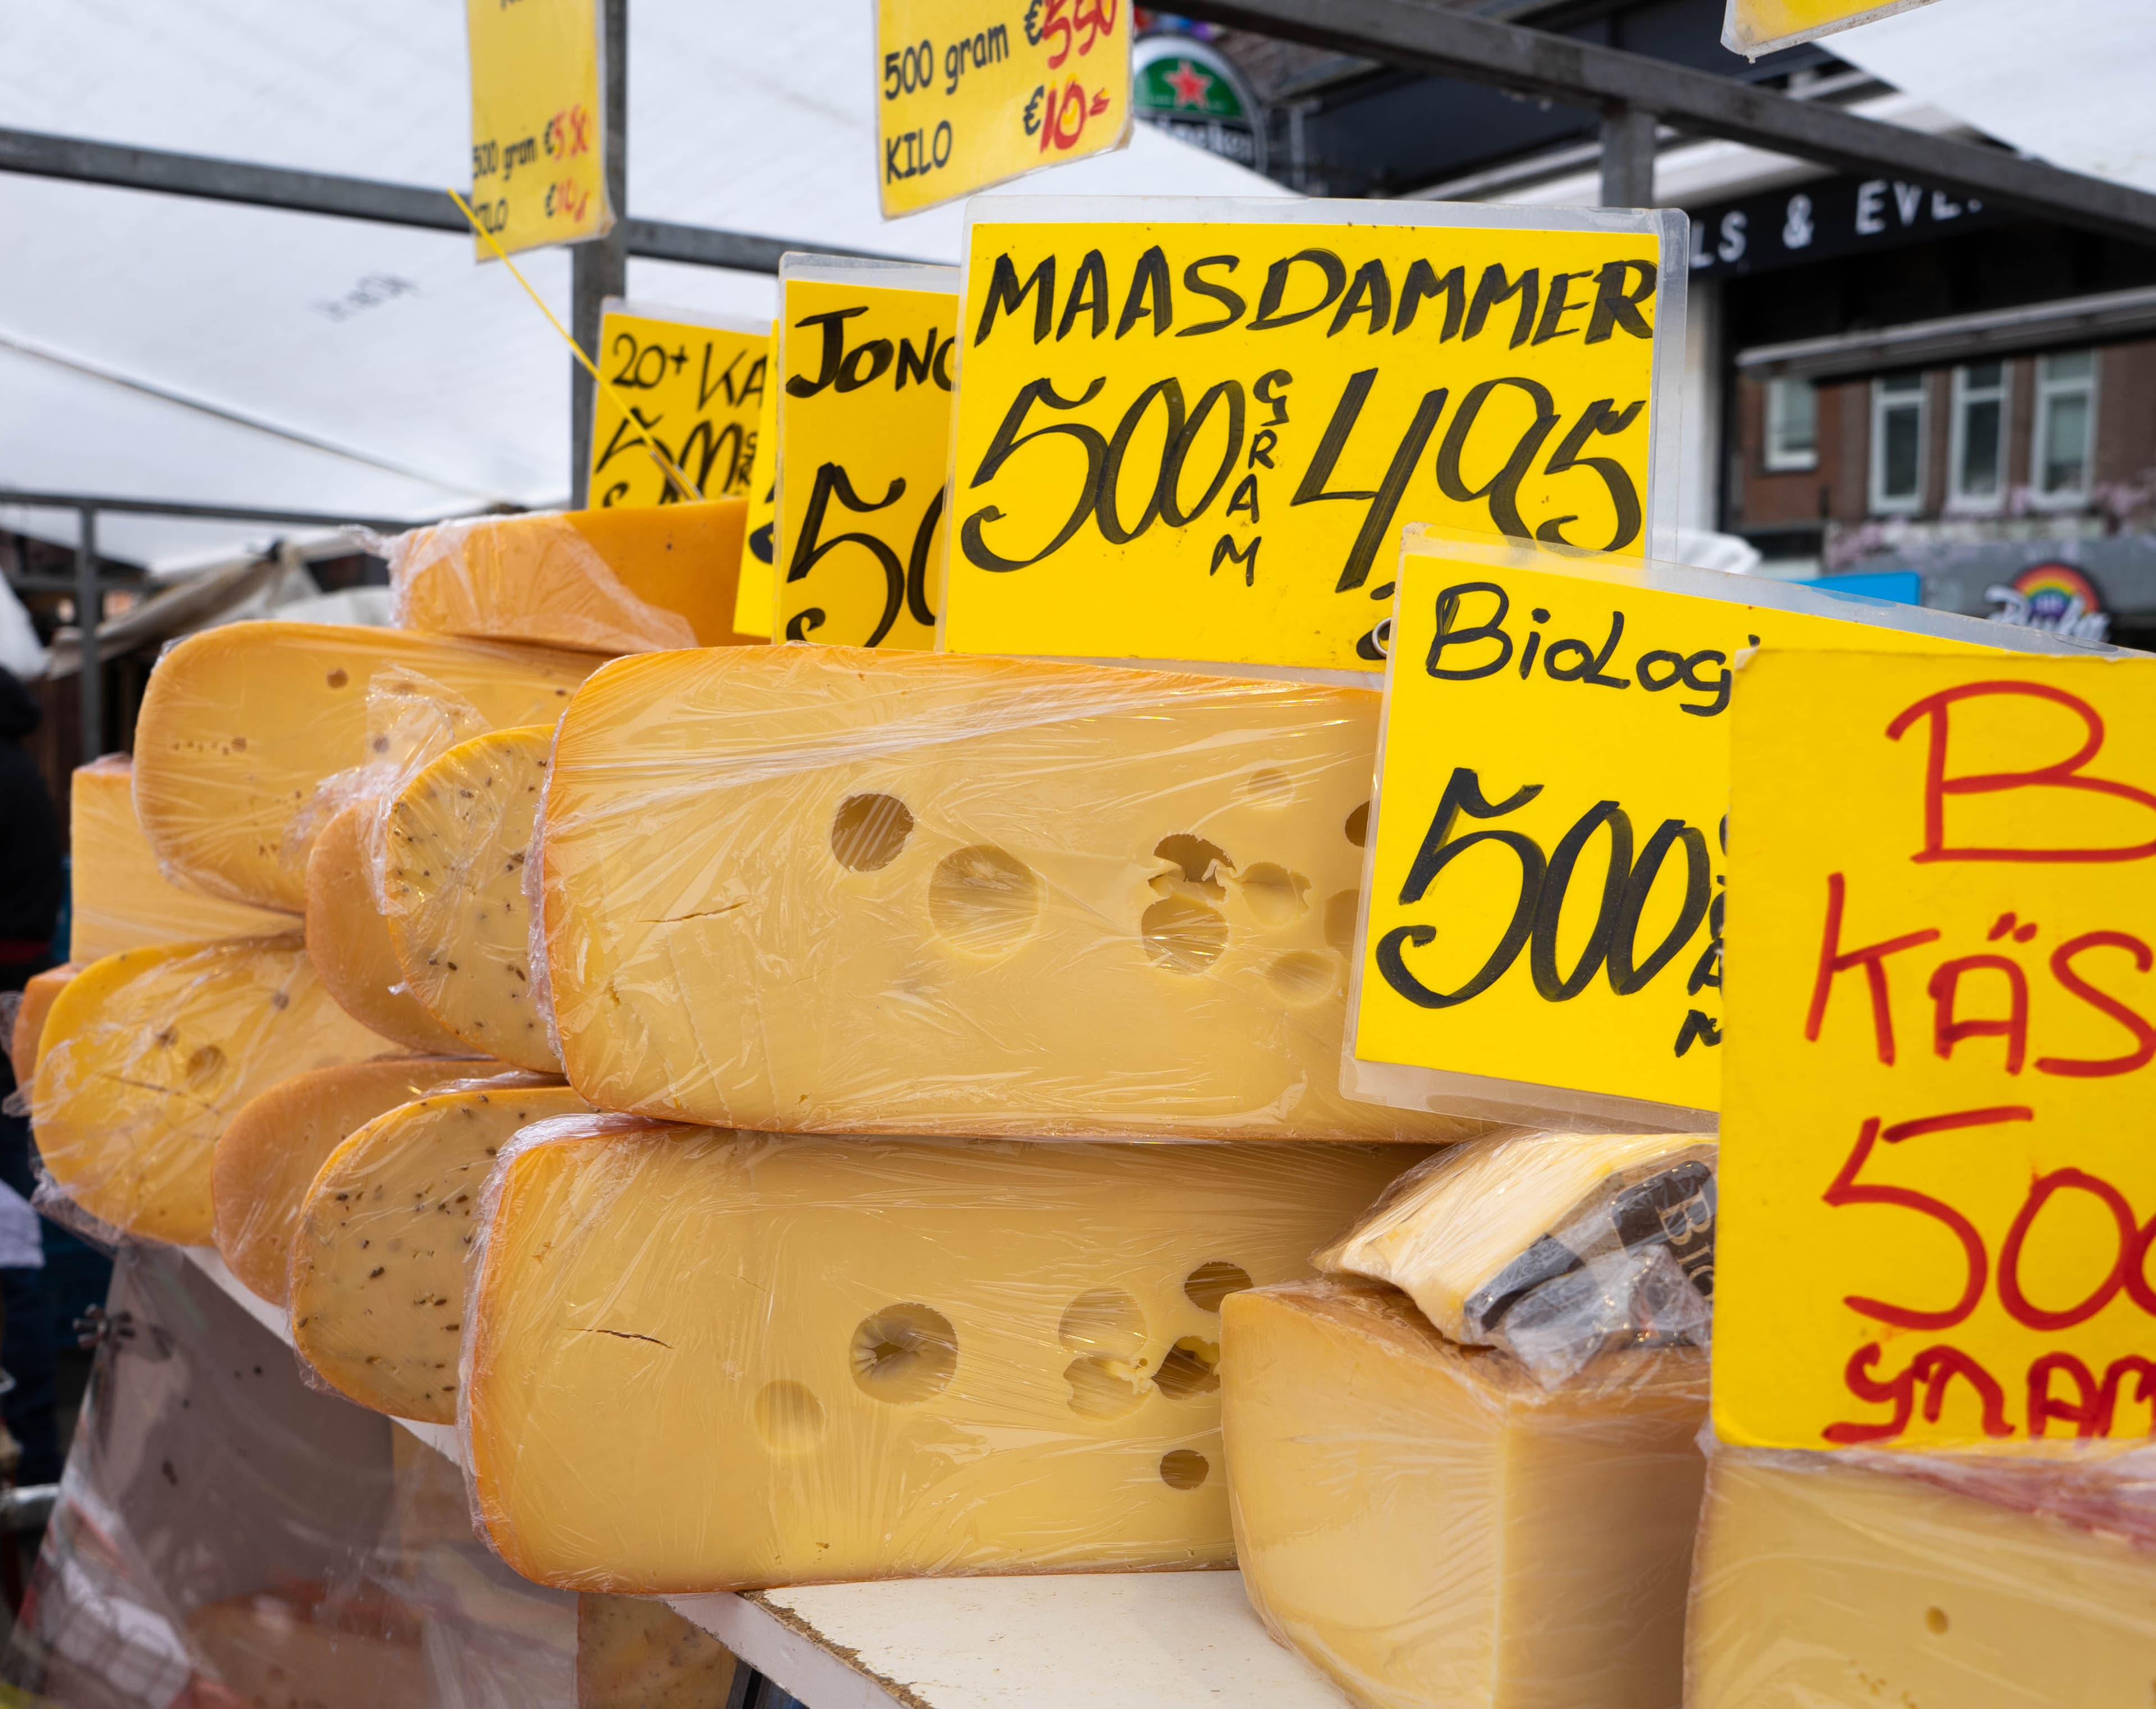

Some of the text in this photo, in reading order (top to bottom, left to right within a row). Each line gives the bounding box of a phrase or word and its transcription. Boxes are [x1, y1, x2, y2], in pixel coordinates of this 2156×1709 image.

[886, 40, 932, 100] 500
[946, 24, 1008, 94] gram
[886, 121, 952, 184] KILO
[1782, 193, 1814, 249] &
[974, 245, 1658, 350] MAASDAMMER
[613, 334, 687, 389] 20+
[961, 376, 1245, 573] 500
[1209, 369, 1294, 587] GRAM
[1886, 681, 2156, 863] B
[1376, 767, 1711, 1009] 500
[1805, 872, 2156, 1078] KÄS
